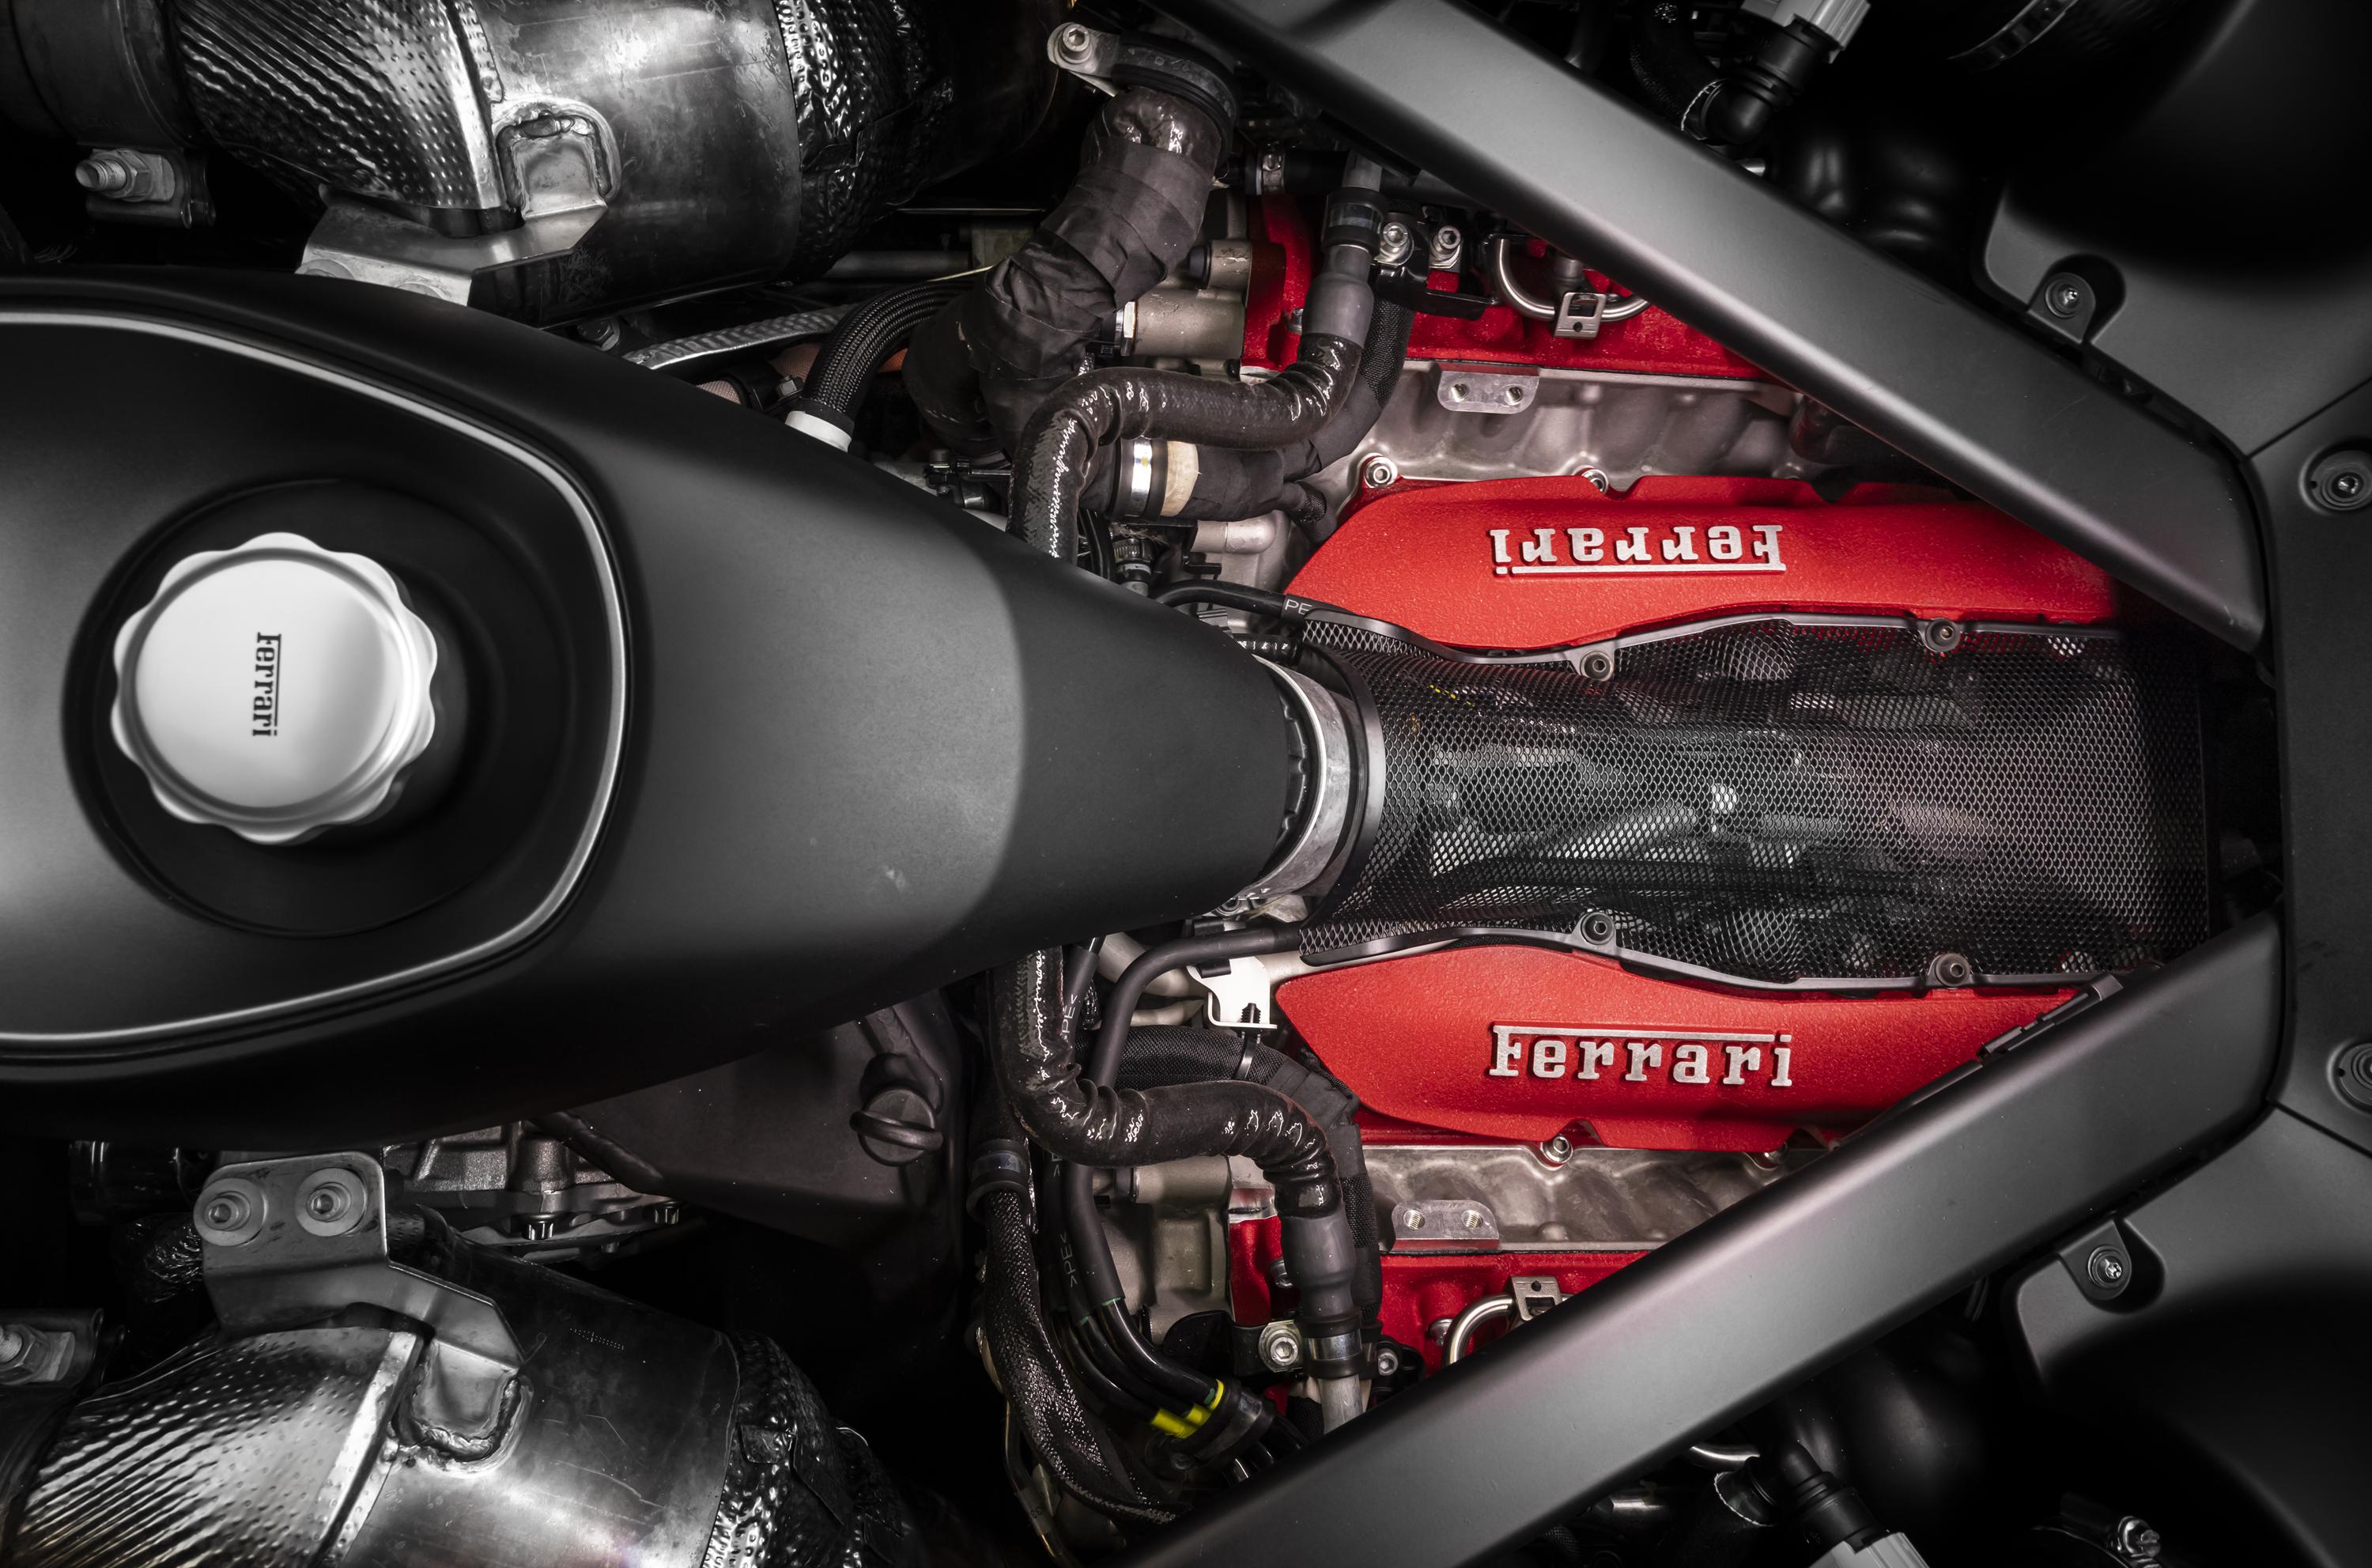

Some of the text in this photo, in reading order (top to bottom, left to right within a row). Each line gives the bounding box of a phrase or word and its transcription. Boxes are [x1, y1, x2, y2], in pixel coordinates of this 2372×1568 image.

[1489, 524, 1787, 574] Ferrari
[251, 632, 281, 736] Ferrari
[1489, 1025, 1792, 1087] Ferrari
